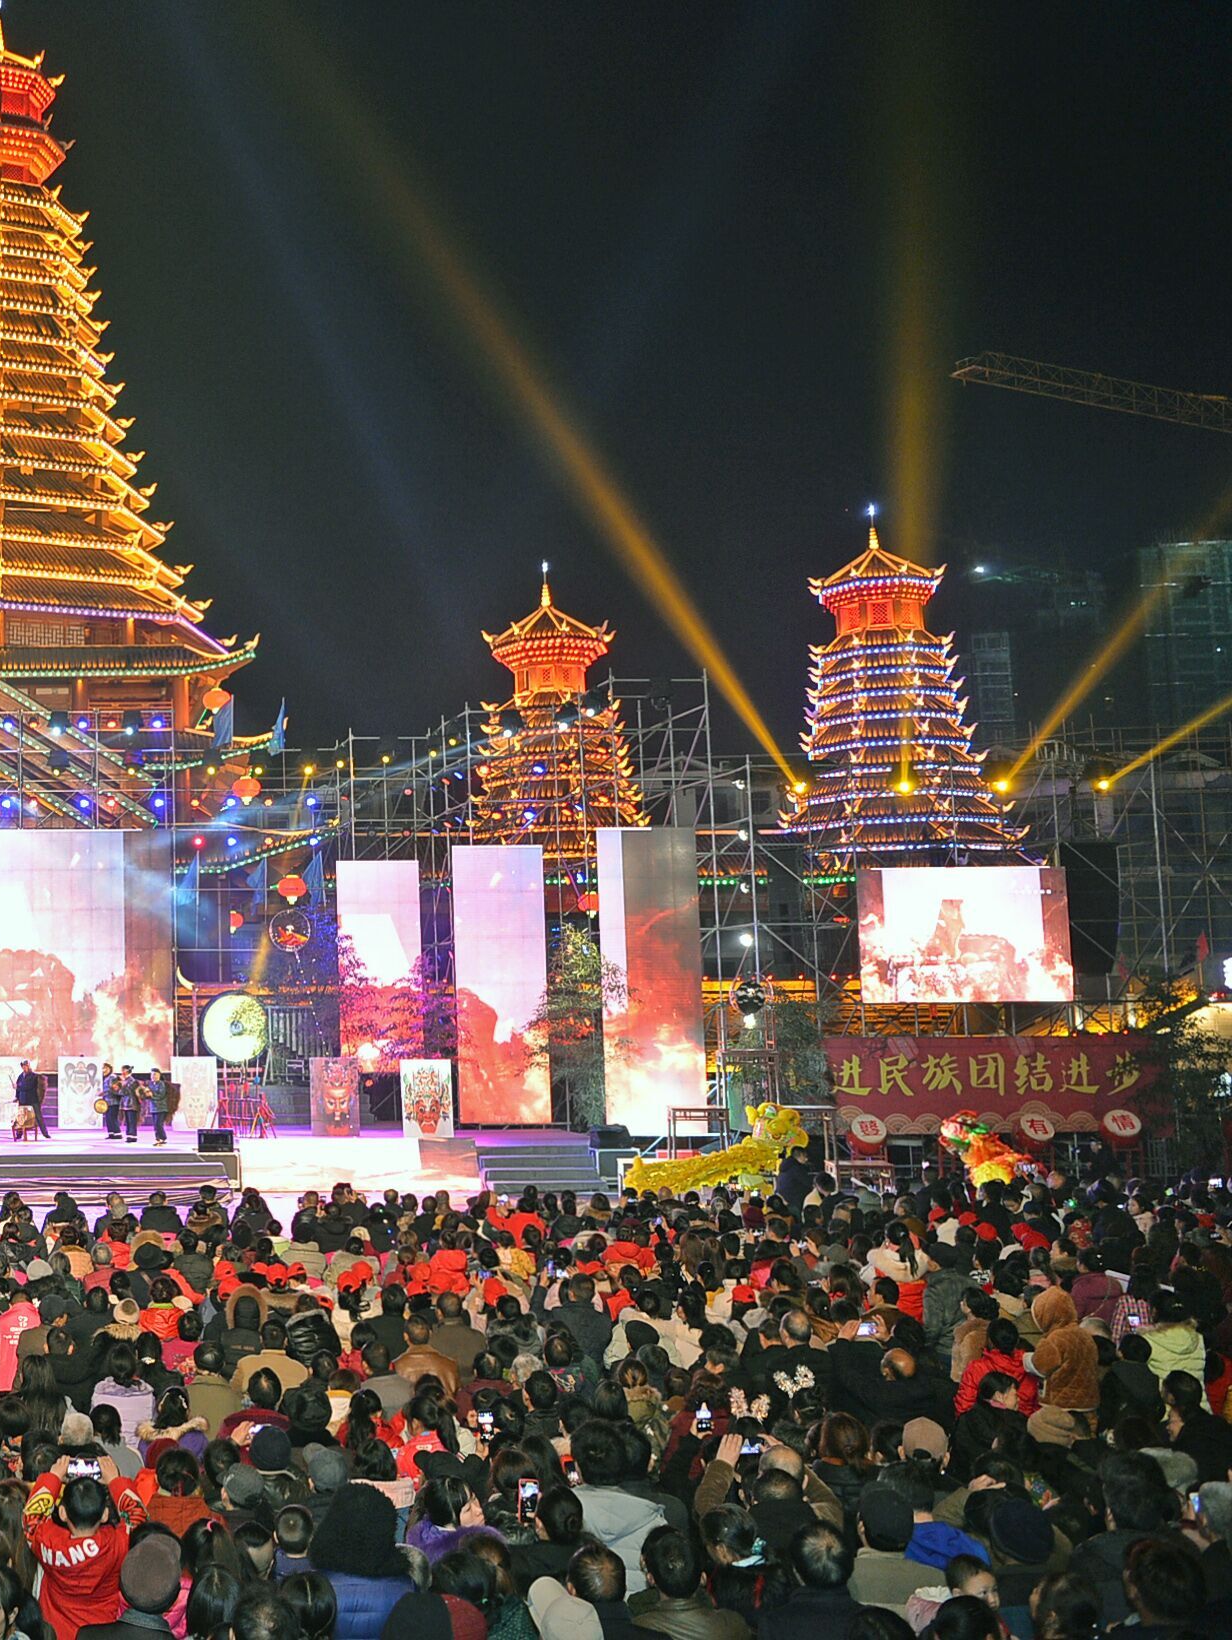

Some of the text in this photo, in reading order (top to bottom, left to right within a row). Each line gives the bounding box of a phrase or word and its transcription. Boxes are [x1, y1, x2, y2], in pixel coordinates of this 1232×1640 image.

[1025, 1118, 1049, 1135] 有
[1111, 1114, 1136, 1131] 情
[40, 1538, 100, 1568] WANG
